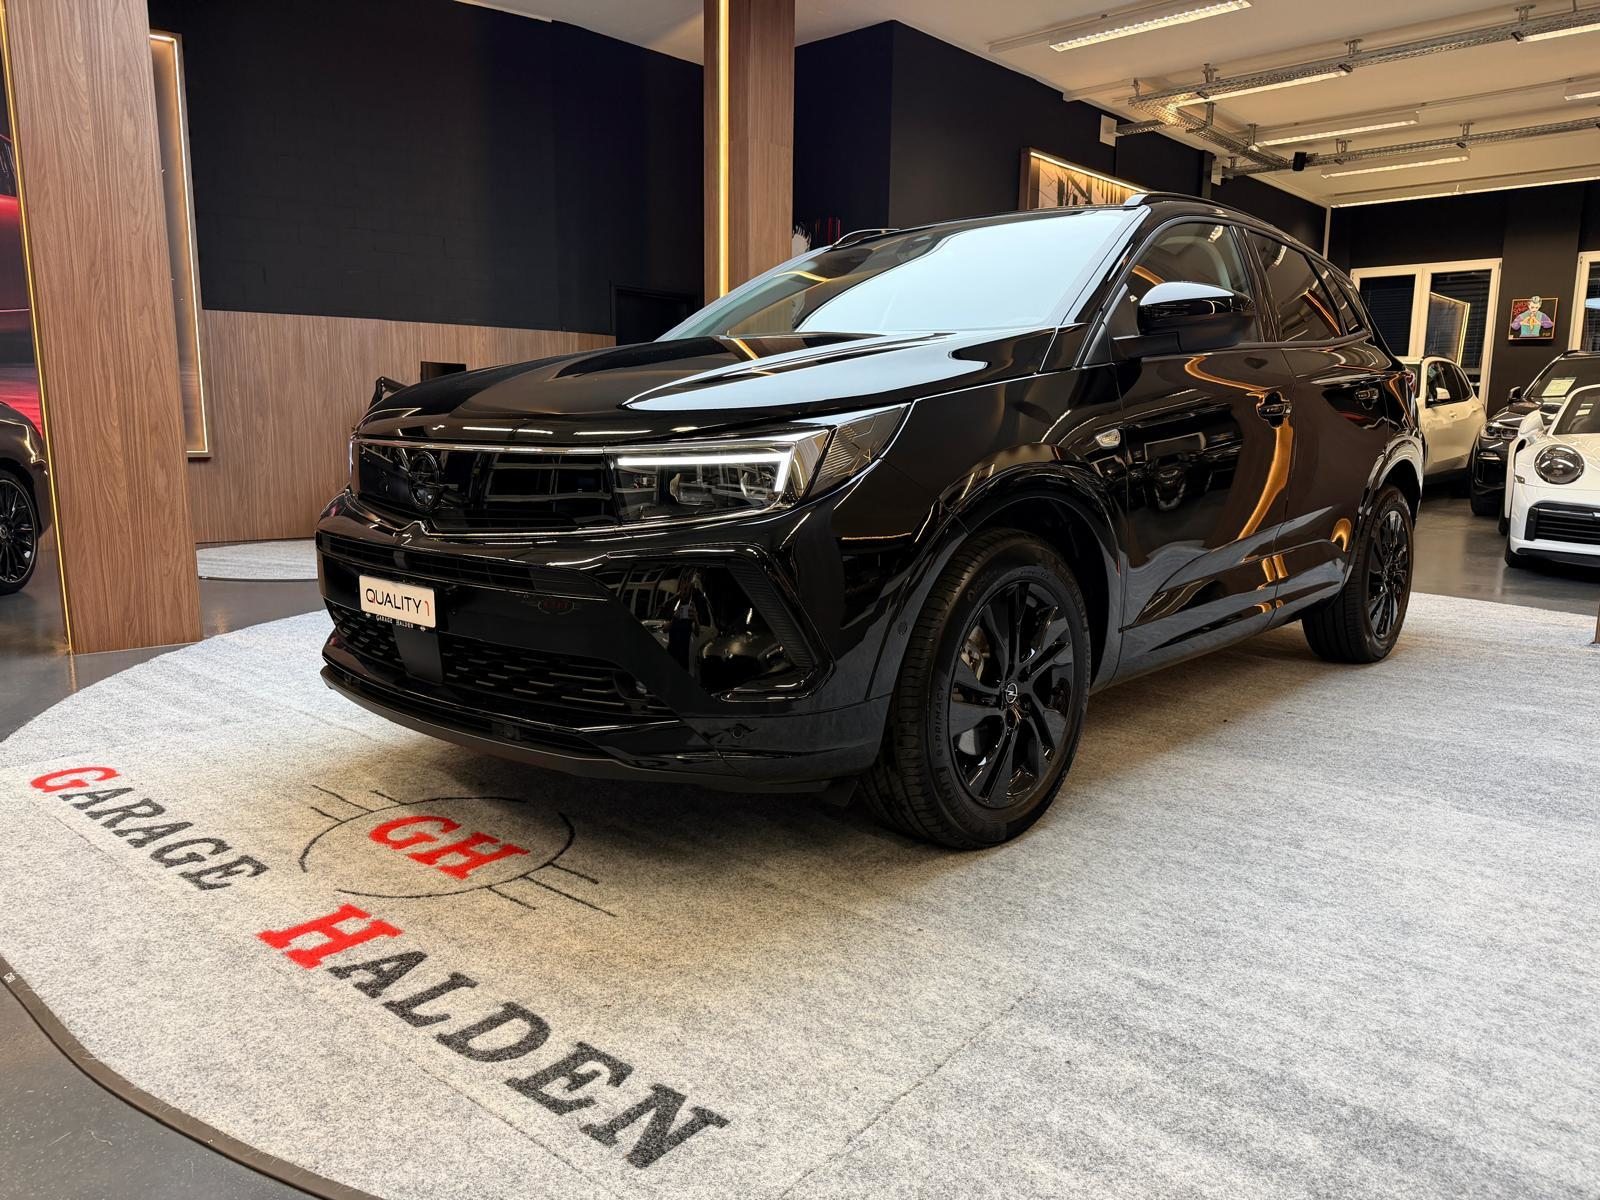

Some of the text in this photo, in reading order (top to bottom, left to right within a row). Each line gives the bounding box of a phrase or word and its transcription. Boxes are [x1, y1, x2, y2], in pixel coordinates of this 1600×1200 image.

[365, 588, 422, 614] QUALITY
[368, 815, 530, 880] GH
[30, 766, 731, 1169] GARAGE HALDEN
